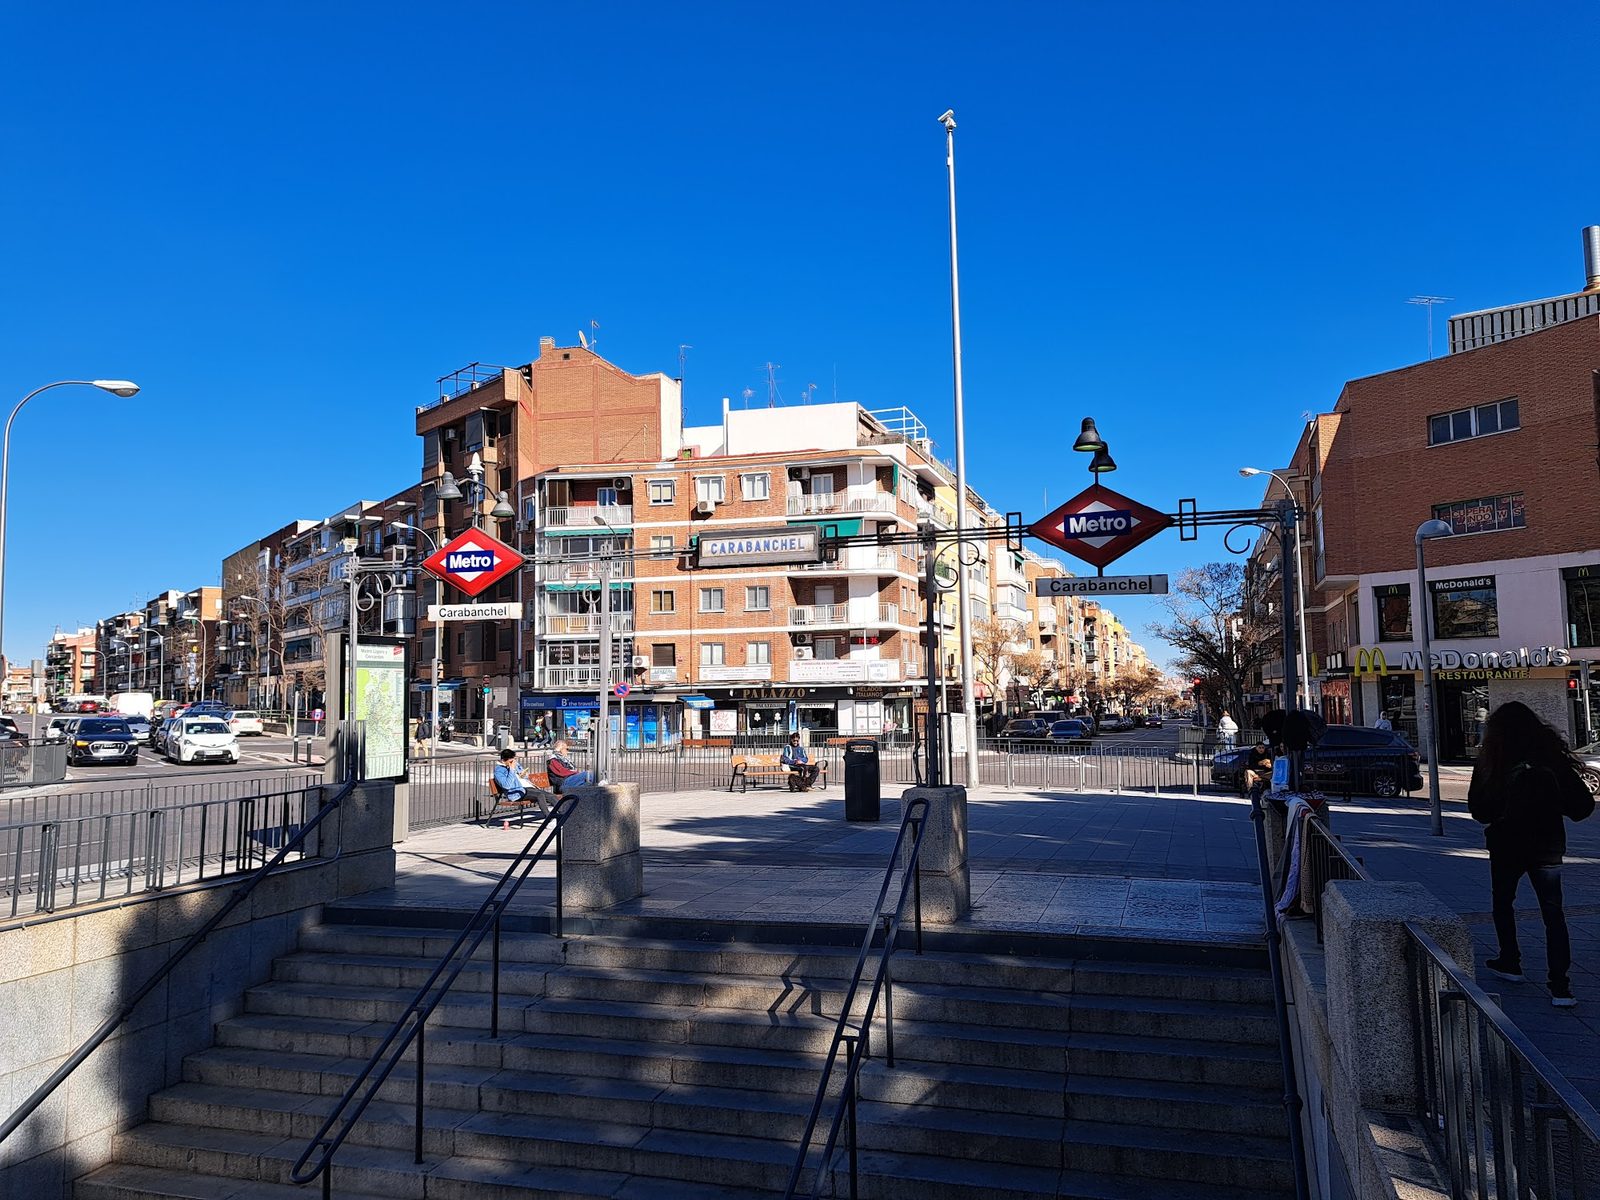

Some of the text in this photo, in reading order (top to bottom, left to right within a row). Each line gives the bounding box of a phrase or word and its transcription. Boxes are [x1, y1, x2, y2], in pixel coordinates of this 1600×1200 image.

[1069, 515, 1127, 533] Metro
[711, 538, 805, 555] CARABANCHEL
[449, 554, 491, 569] Metro
[1050, 578, 1152, 592] Carabanchel
[1436, 578, 1491, 590] McDonald's
[439, 606, 507, 618] Carabanchel
[1401, 645, 1571, 671] McDonald's
[1439, 670, 1528, 680] RESTAURANTE
[743, 688, 806, 699] PALAZZO
